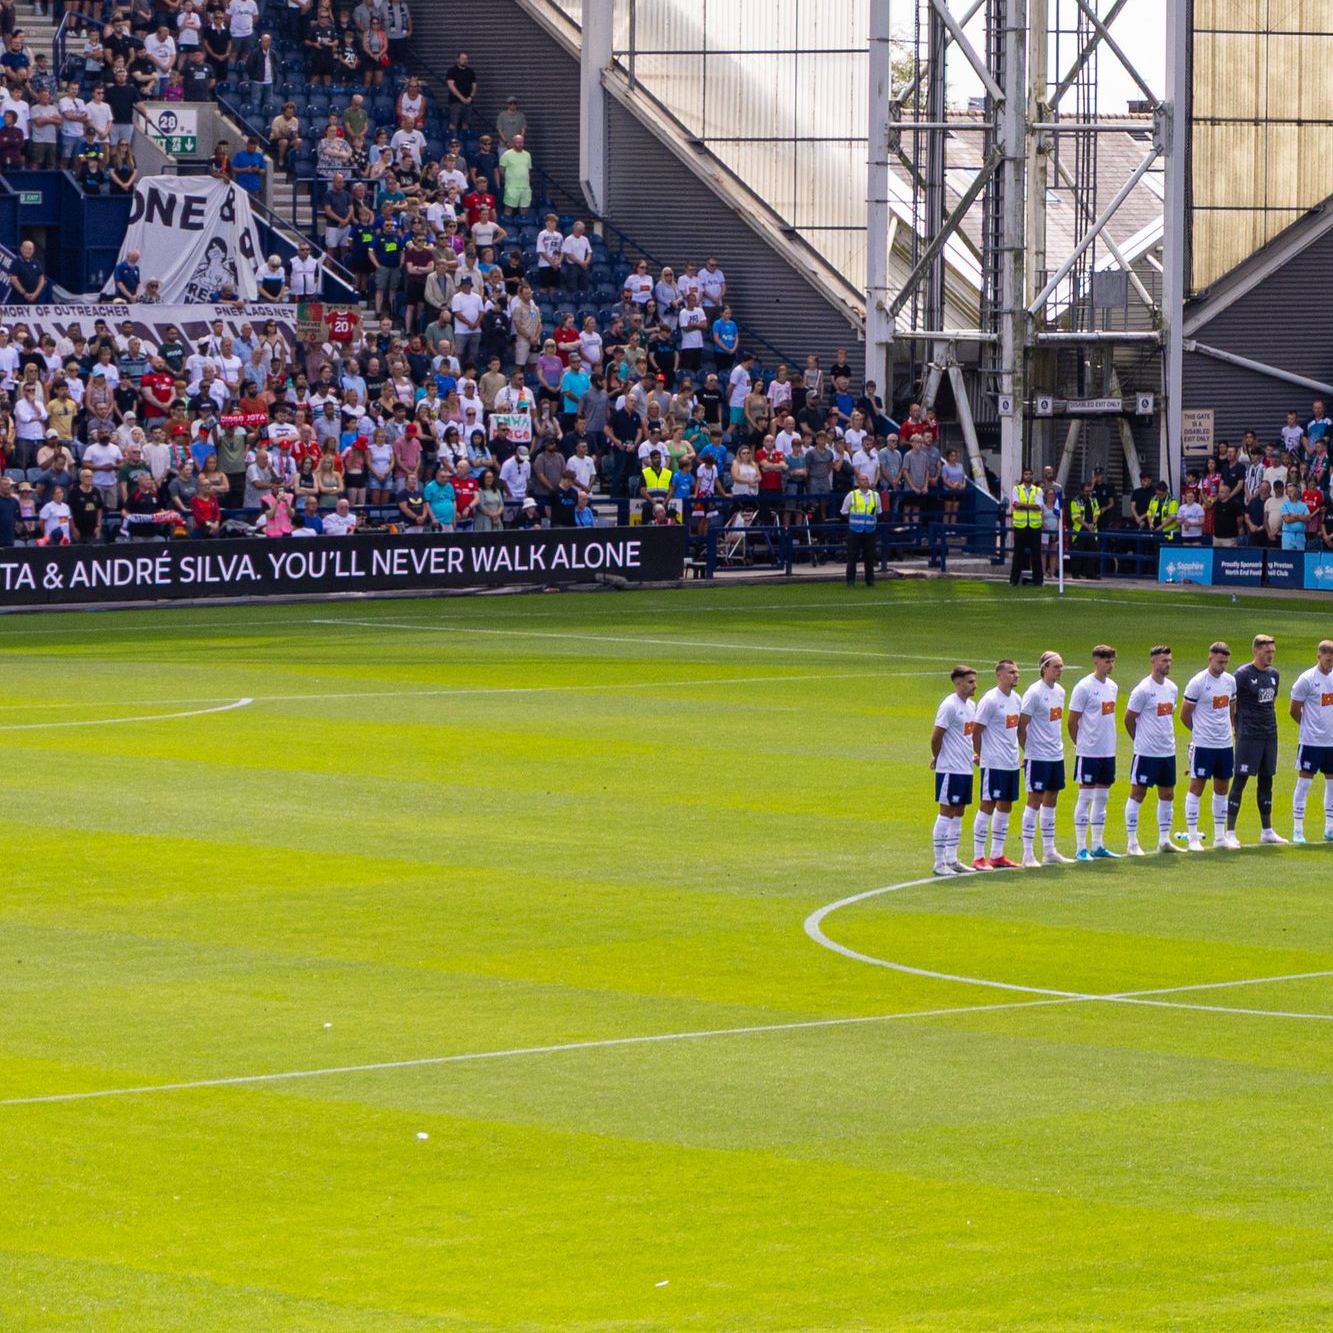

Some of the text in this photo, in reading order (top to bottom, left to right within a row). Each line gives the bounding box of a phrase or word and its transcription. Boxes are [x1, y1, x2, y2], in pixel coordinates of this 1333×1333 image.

[160, 116, 177, 129] 28
[334, 320, 350, 333] 20
[1, 562, 36, 591] TA
[43, 563, 64, 590] &
[69, 550, 173, 590] ANDRÉ
[179, 553, 263, 584] SILVA.
[372, 546, 464, 577] NEVER
[471, 544, 547, 574] WALK
[551, 541, 642, 570] ALONE
